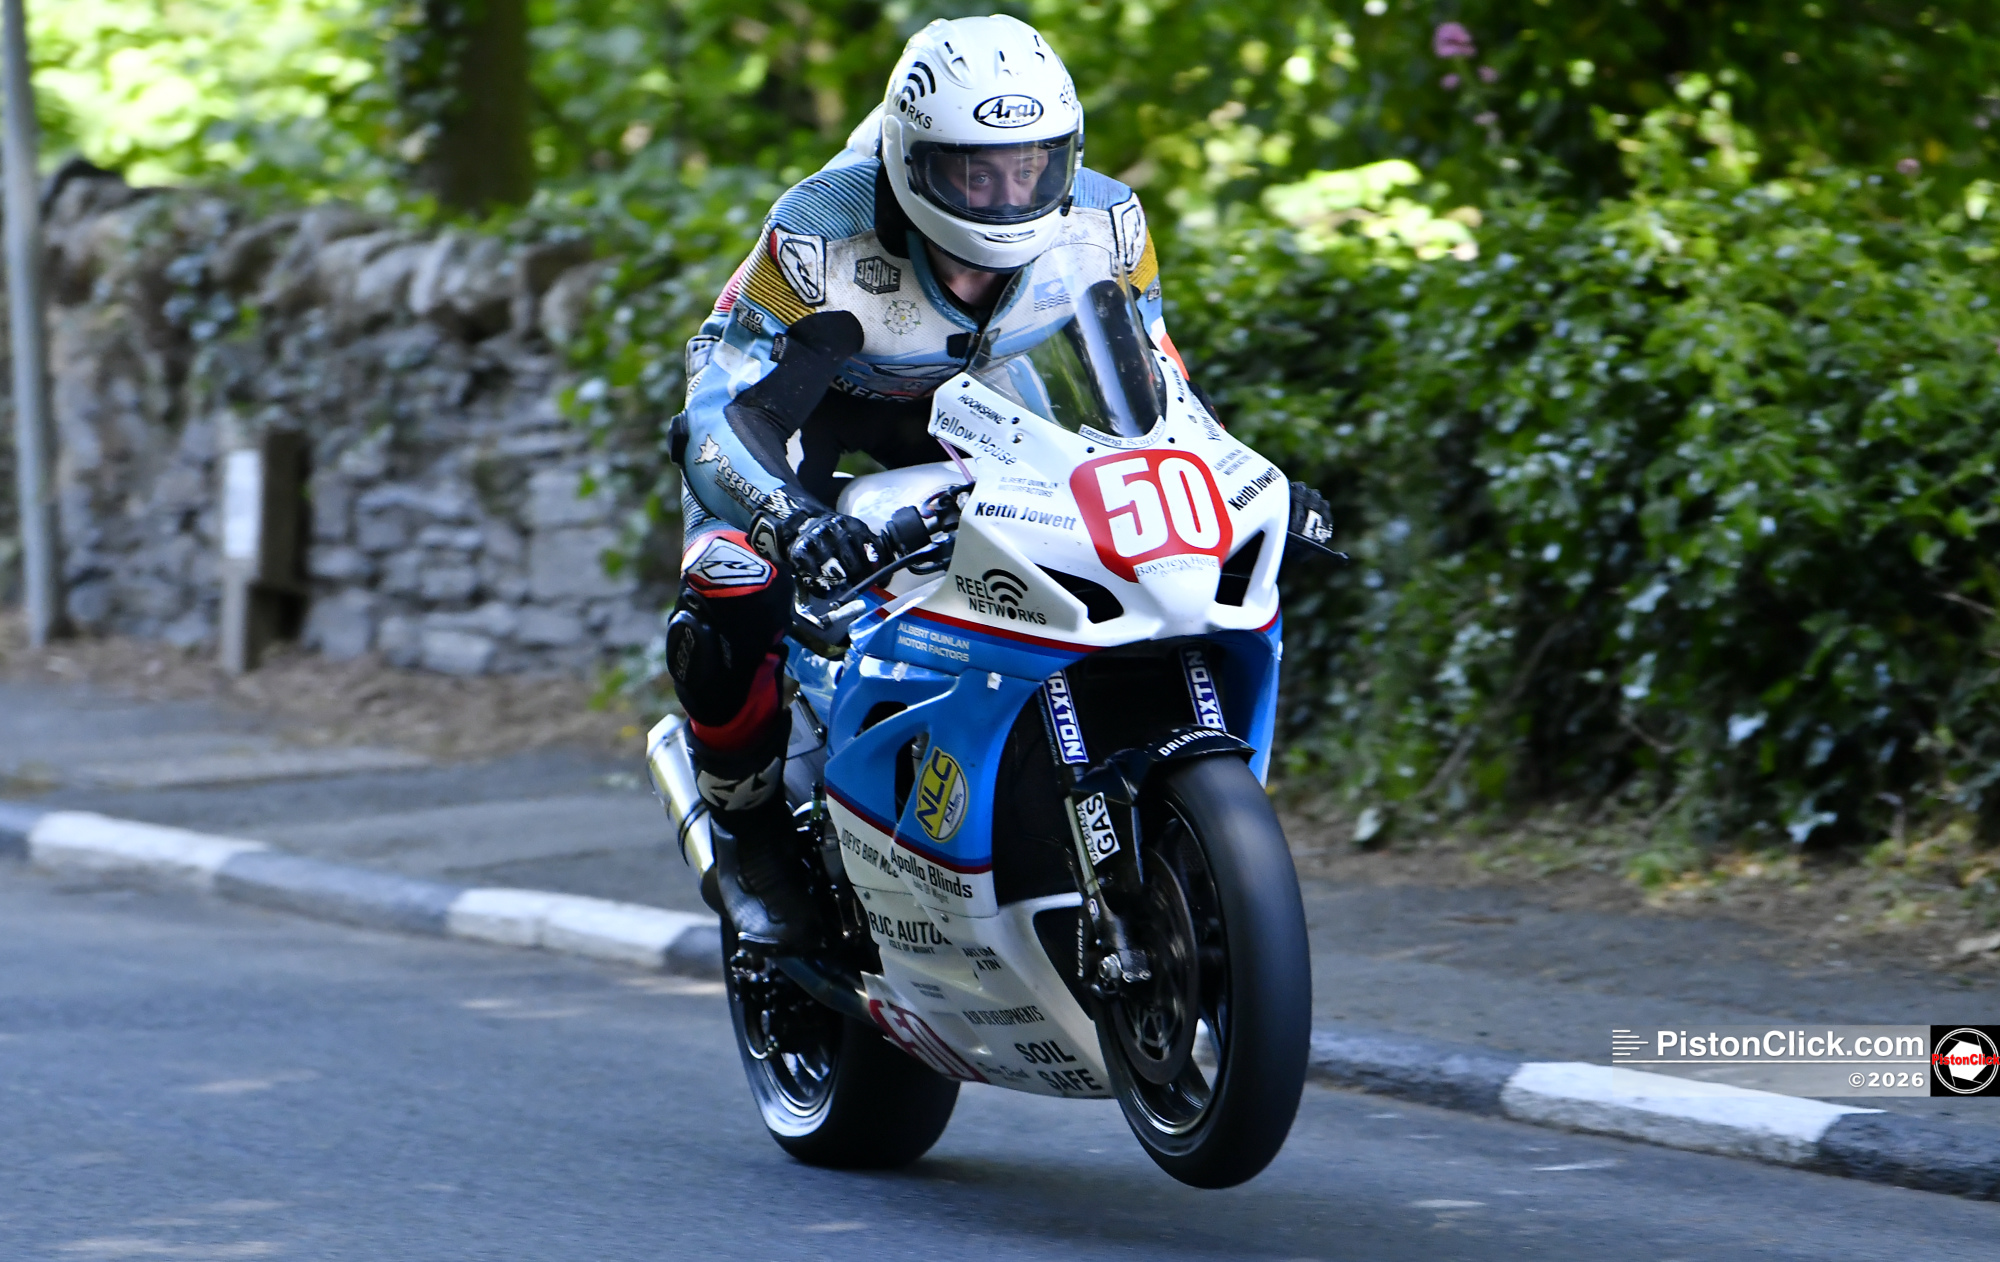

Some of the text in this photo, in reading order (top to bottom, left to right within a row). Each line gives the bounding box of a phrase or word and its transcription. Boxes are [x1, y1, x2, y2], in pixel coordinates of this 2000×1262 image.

[979, 99, 1036, 119] Arai
[933, 408, 1018, 465] Yellow House
[1228, 467, 1281, 511] Keith Jowett
[975, 502, 1077, 530] Keith Jowett
[1094, 457, 1221, 558] 50
[955, 575, 994, 600] REEL
[969, 597, 1047, 625] NETWORKS
[897, 623, 970, 650] ALBERT QUINLAN
[898, 634, 970, 662] MOTOR FACTORS
[1186, 650, 1223, 728] AXTON
[917, 750, 953, 831] NLC
[1086, 795, 1115, 854] GAS
[862, 843, 879, 867] BAR
[891, 847, 973, 898] Apollo Blinds
[1014, 1040, 1077, 1065] SOIL
[1037, 1068, 1103, 1091] SAFE
